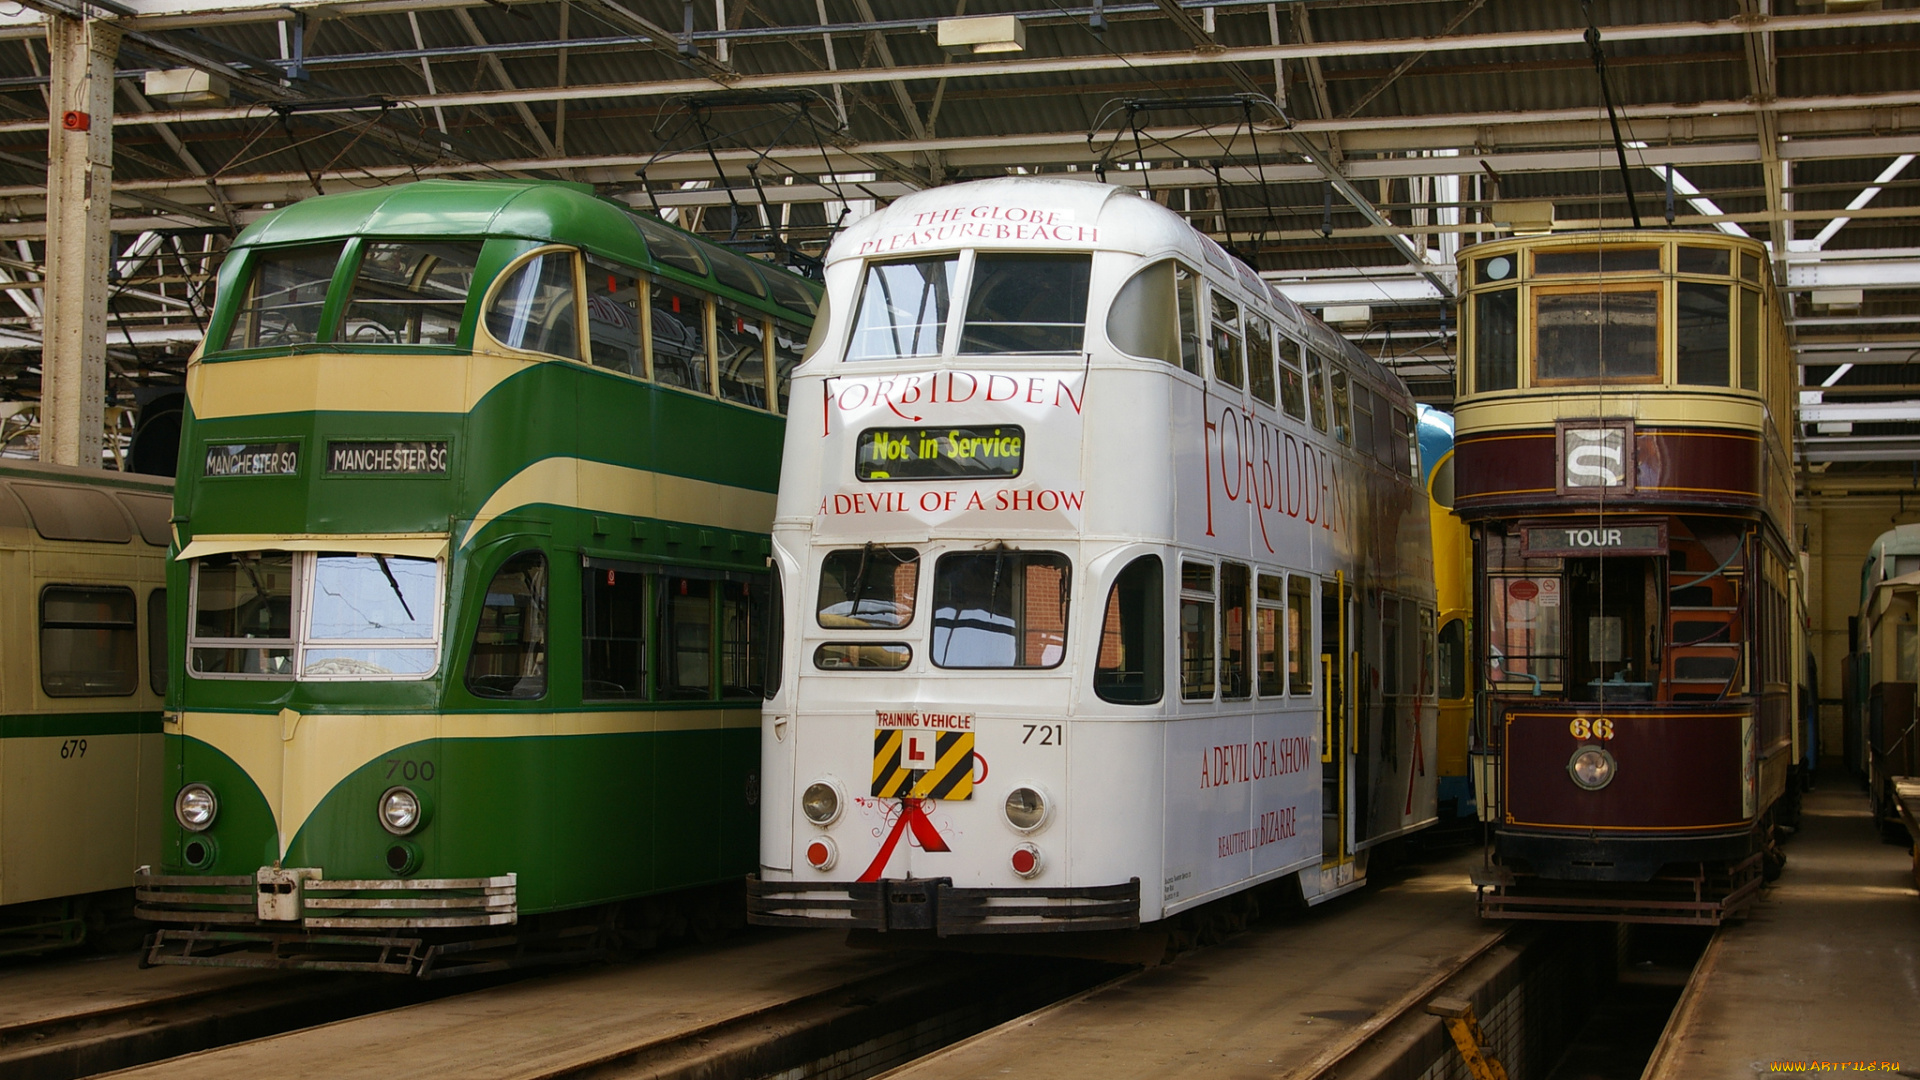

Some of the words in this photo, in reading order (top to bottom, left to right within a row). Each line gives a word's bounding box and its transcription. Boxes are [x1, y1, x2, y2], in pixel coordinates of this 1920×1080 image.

[914, 207, 966, 227] THE
[970, 205, 1062, 226] GLOBE
[821, 353, 1090, 438] FORBIDDEN
[873, 432, 910, 460] Not
[919, 431, 938, 459] in
[948, 429, 1021, 458] Service
[206, 452, 279, 475] MANCHESTER
[280, 451, 297, 472] SQ
[334, 449, 427, 470] MANCHESTER
[1203, 381, 1349, 553] FORBIDDEN
[818, 495, 828, 515] A
[834, 492, 910, 515] DEVIL
[919, 491, 958, 512] OF
[965, 490, 987, 511] A
[995, 489, 1086, 511] SHOW
[1565, 529, 1622, 546] TOUR
[878, 712, 920, 727] TRAINING
[923, 713, 970, 729] VEHICLE
[1569, 718, 1614, 741] 66
[1022, 724, 1062, 746] 721
[60, 739, 88, 759] 679
[909, 738, 925, 761] L
[386, 759, 435, 781] 700
[1200, 746, 1210, 789] A
[1213, 743, 1249, 787] DEVIL
[1253, 741, 1268, 780] OF
[1269, 740, 1278, 777] A
[1279, 736, 1311, 775] SHOW
[1218, 827, 1260, 858] BEAUTIFULLY
[1260, 806, 1297, 847] BIZARRE
